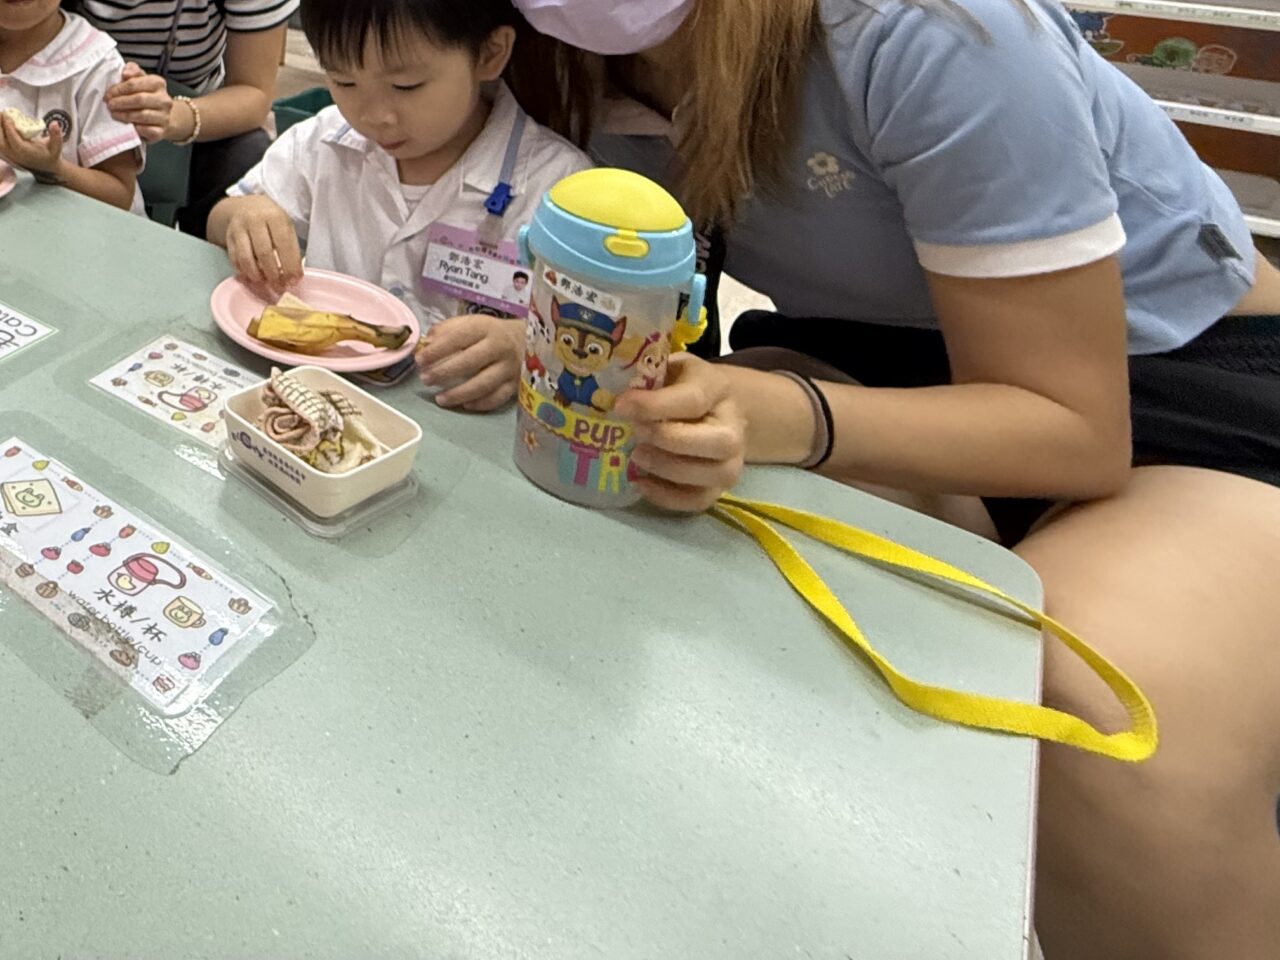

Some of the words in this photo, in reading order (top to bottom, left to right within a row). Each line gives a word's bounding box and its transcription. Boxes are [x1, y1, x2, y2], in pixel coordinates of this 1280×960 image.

[440, 259, 463, 273] Ryan
[464, 267, 489, 284] Tang
[574, 419, 625, 445] PUP
[93, 588, 167, 642] 水樽/杯
